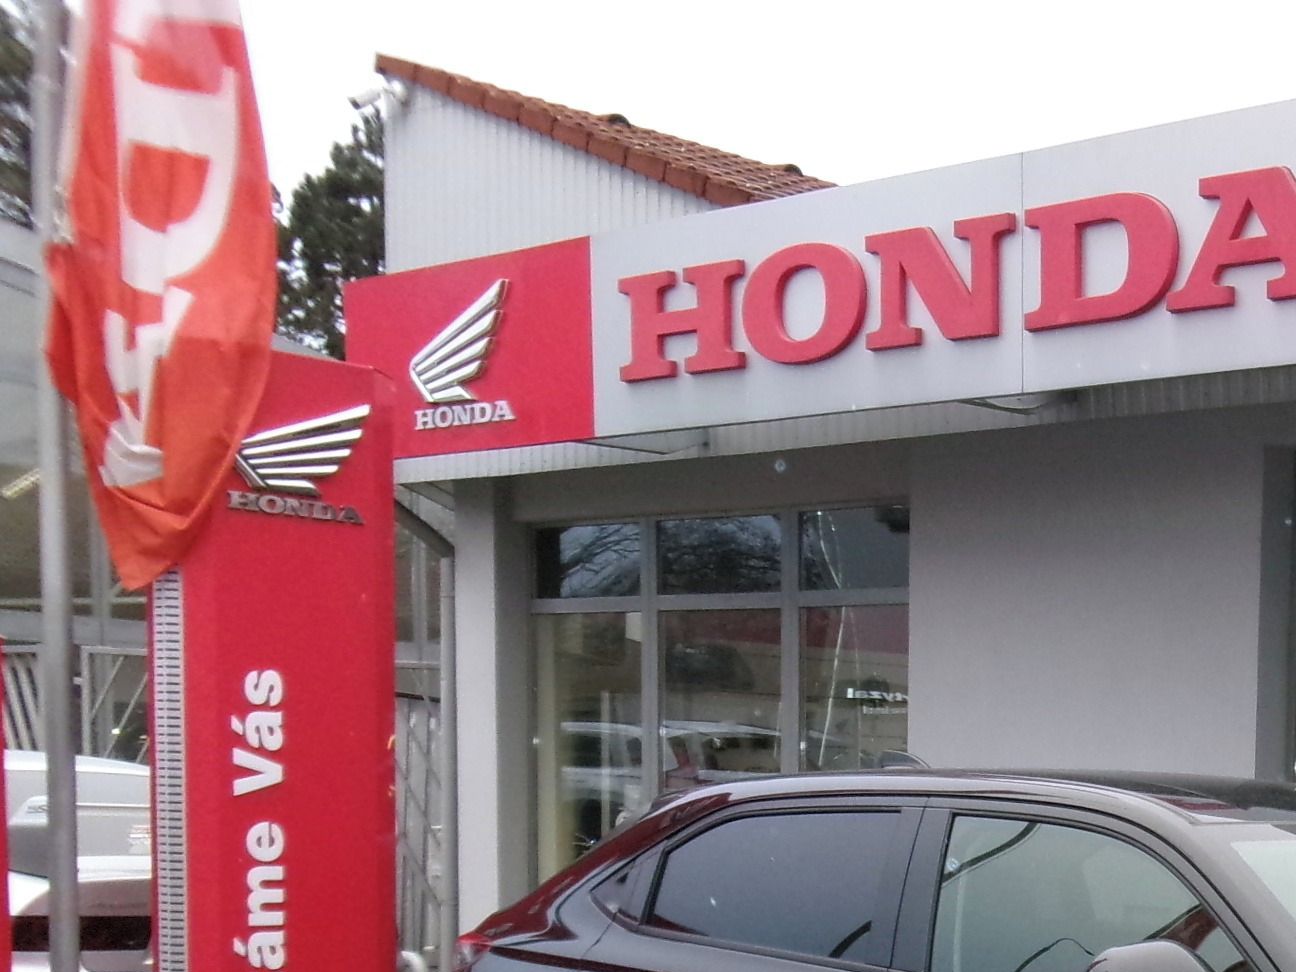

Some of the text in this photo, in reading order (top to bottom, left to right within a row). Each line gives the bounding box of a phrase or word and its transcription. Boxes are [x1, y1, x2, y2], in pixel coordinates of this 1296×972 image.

[414, 399, 517, 431] HONDA
[226, 489, 366, 526] HONDA
[231, 668, 284, 797] Vás
